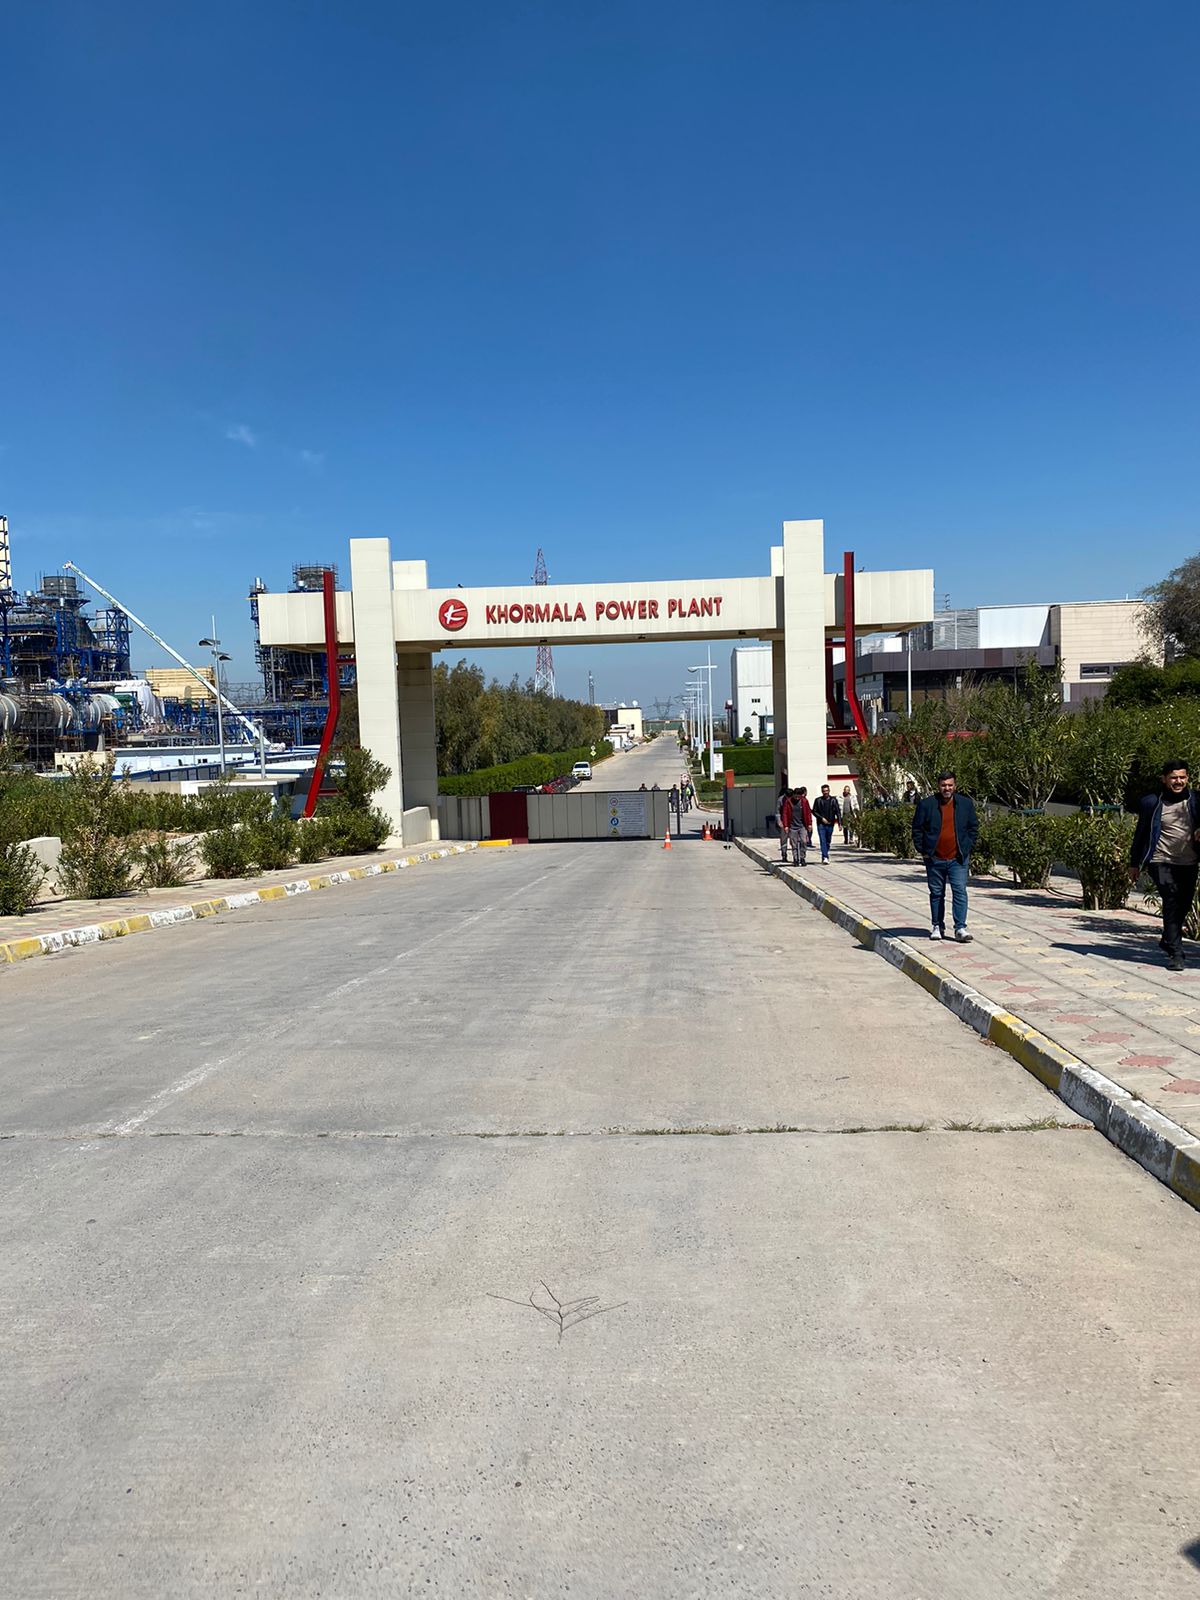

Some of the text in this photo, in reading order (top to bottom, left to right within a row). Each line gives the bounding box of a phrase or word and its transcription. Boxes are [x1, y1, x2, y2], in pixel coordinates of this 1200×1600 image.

[486, 597, 722, 624] KHORMALA POWER PLANT
